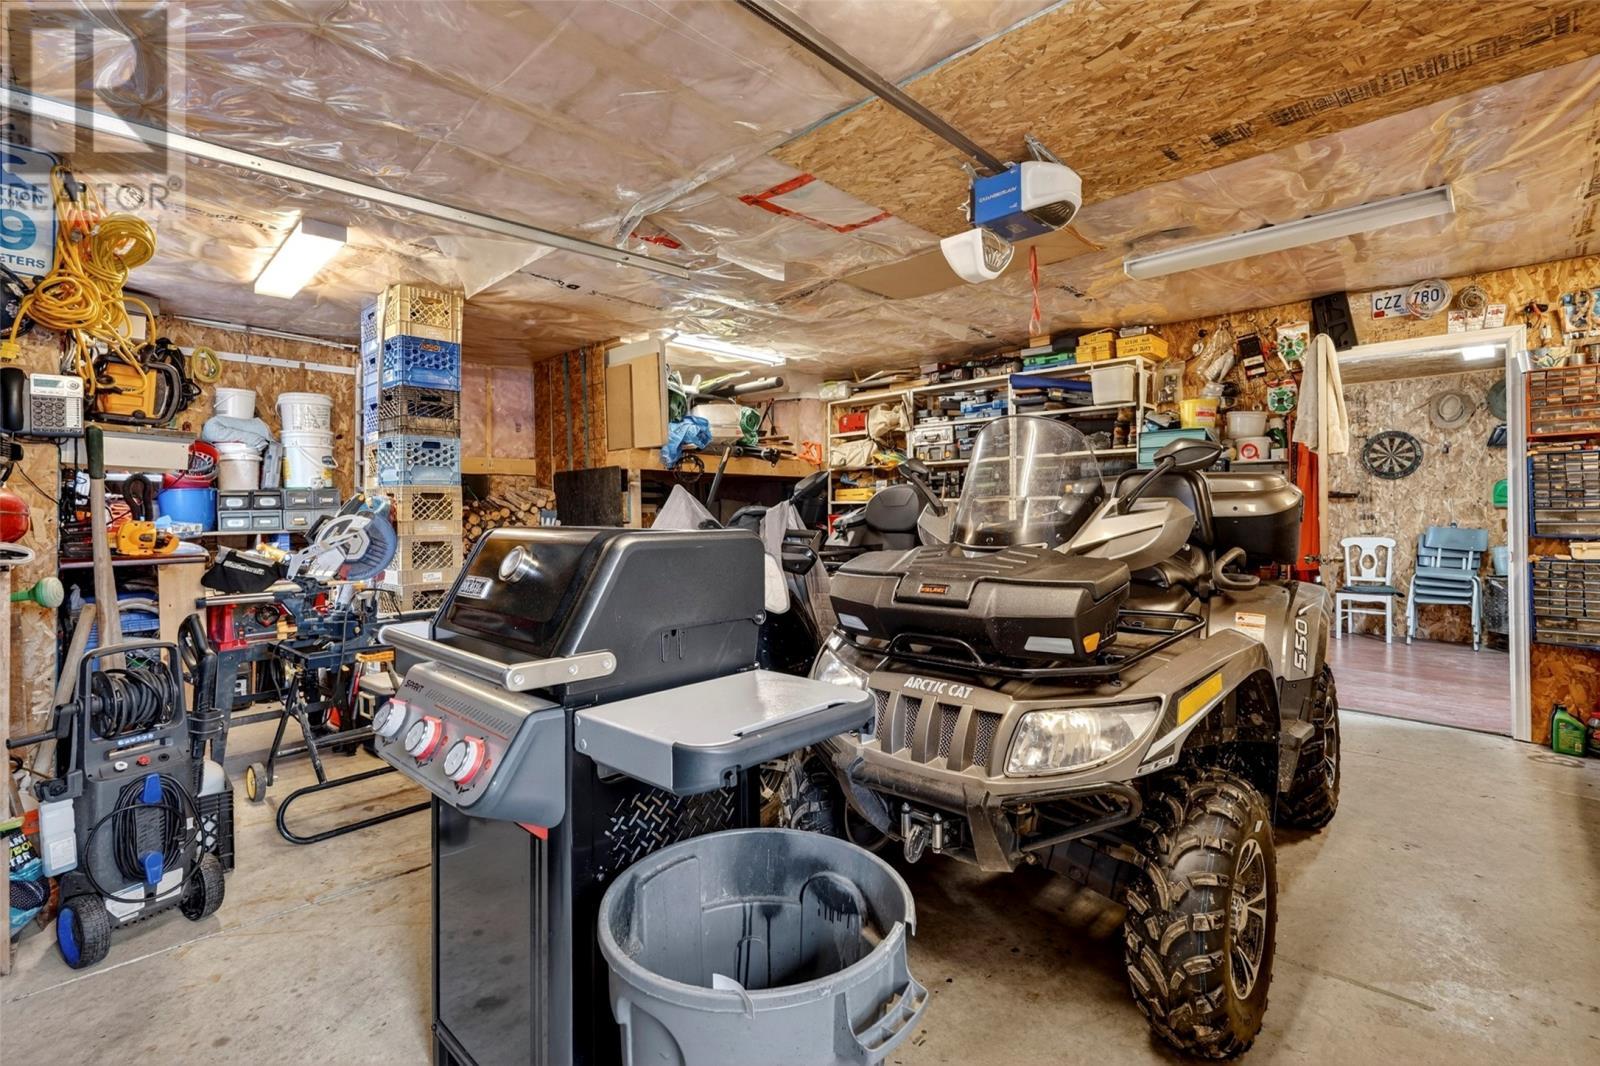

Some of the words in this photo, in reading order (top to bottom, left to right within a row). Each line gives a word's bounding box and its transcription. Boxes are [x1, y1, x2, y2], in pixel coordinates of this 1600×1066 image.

[1375, 294, 1402, 311] CZZ
[1294, 618, 1308, 673] 550
[903, 676, 948, 694] ARCTIC
[948, 684, 974, 699] CAT
